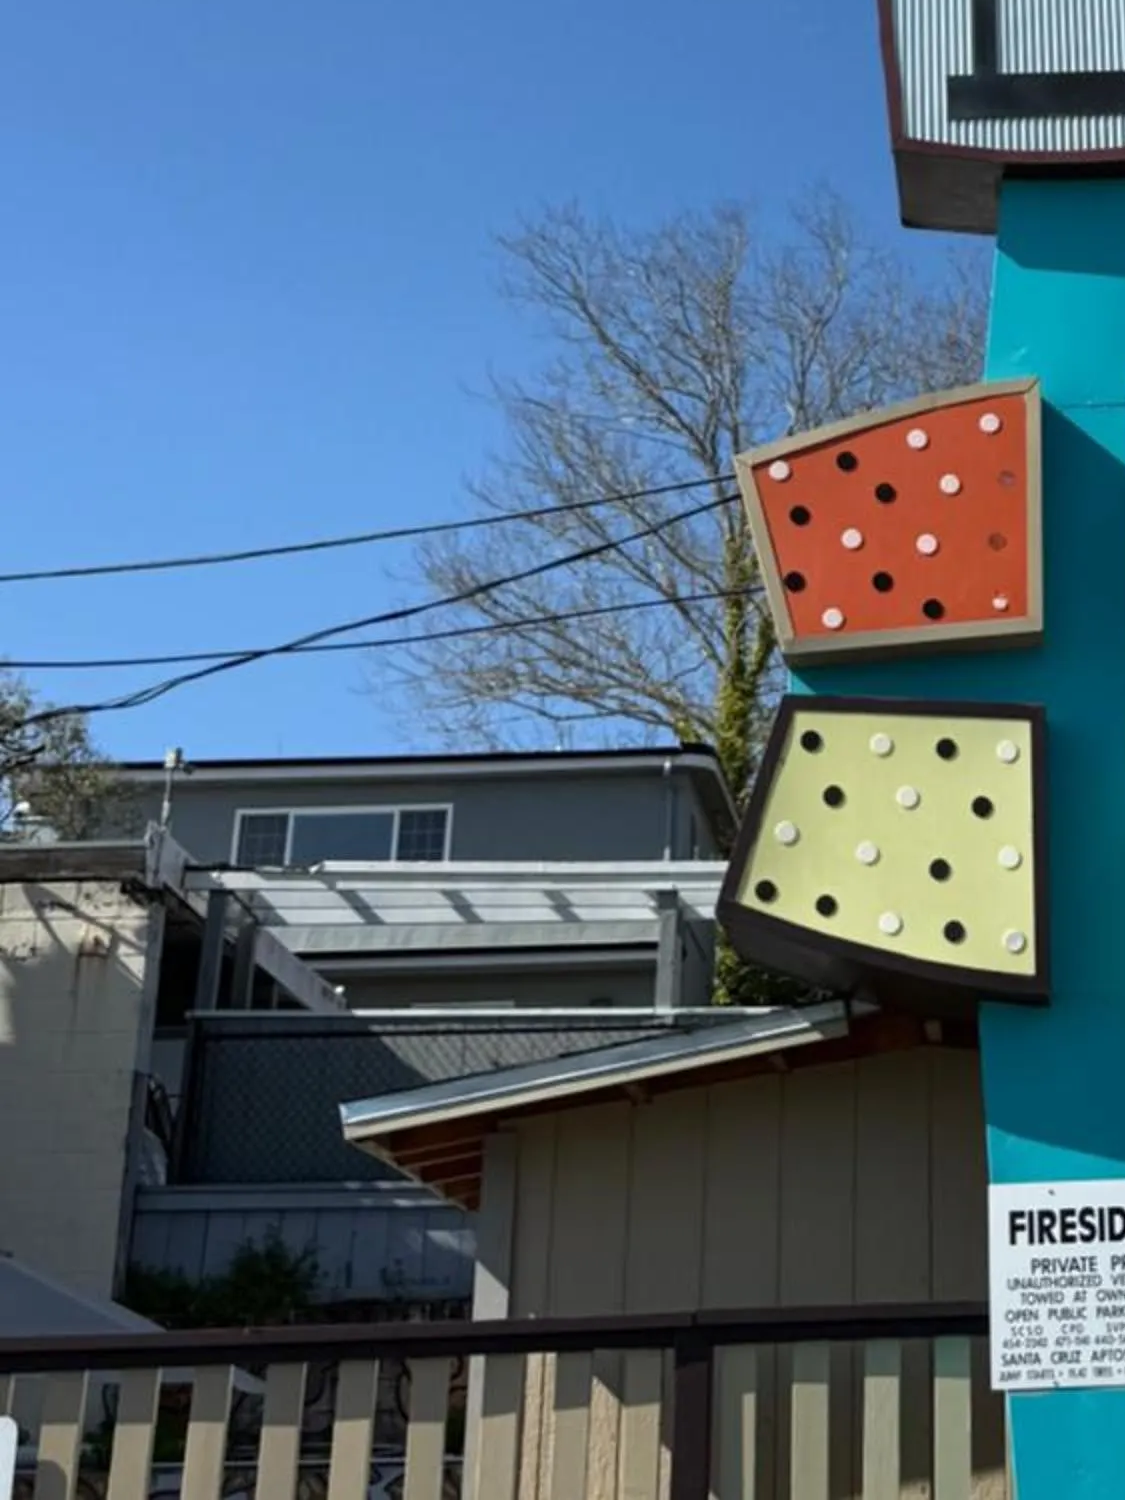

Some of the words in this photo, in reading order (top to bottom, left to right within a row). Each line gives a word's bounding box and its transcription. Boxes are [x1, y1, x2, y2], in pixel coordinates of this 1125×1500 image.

[1031, 1255, 1098, 1274] PRIVATE
[1007, 1274, 1102, 1290] UNAUTHORIZED
[1020, 1290, 1064, 1305] TOWED
[1073, 1289, 1087, 1303] AT
[1005, 1308, 1039, 1324] OPEN
[1048, 1306, 1087, 1321] PUBLIC
[1001, 1351, 1041, 1367] SANTA
[1050, 1349, 1082, 1365] CRUZ
